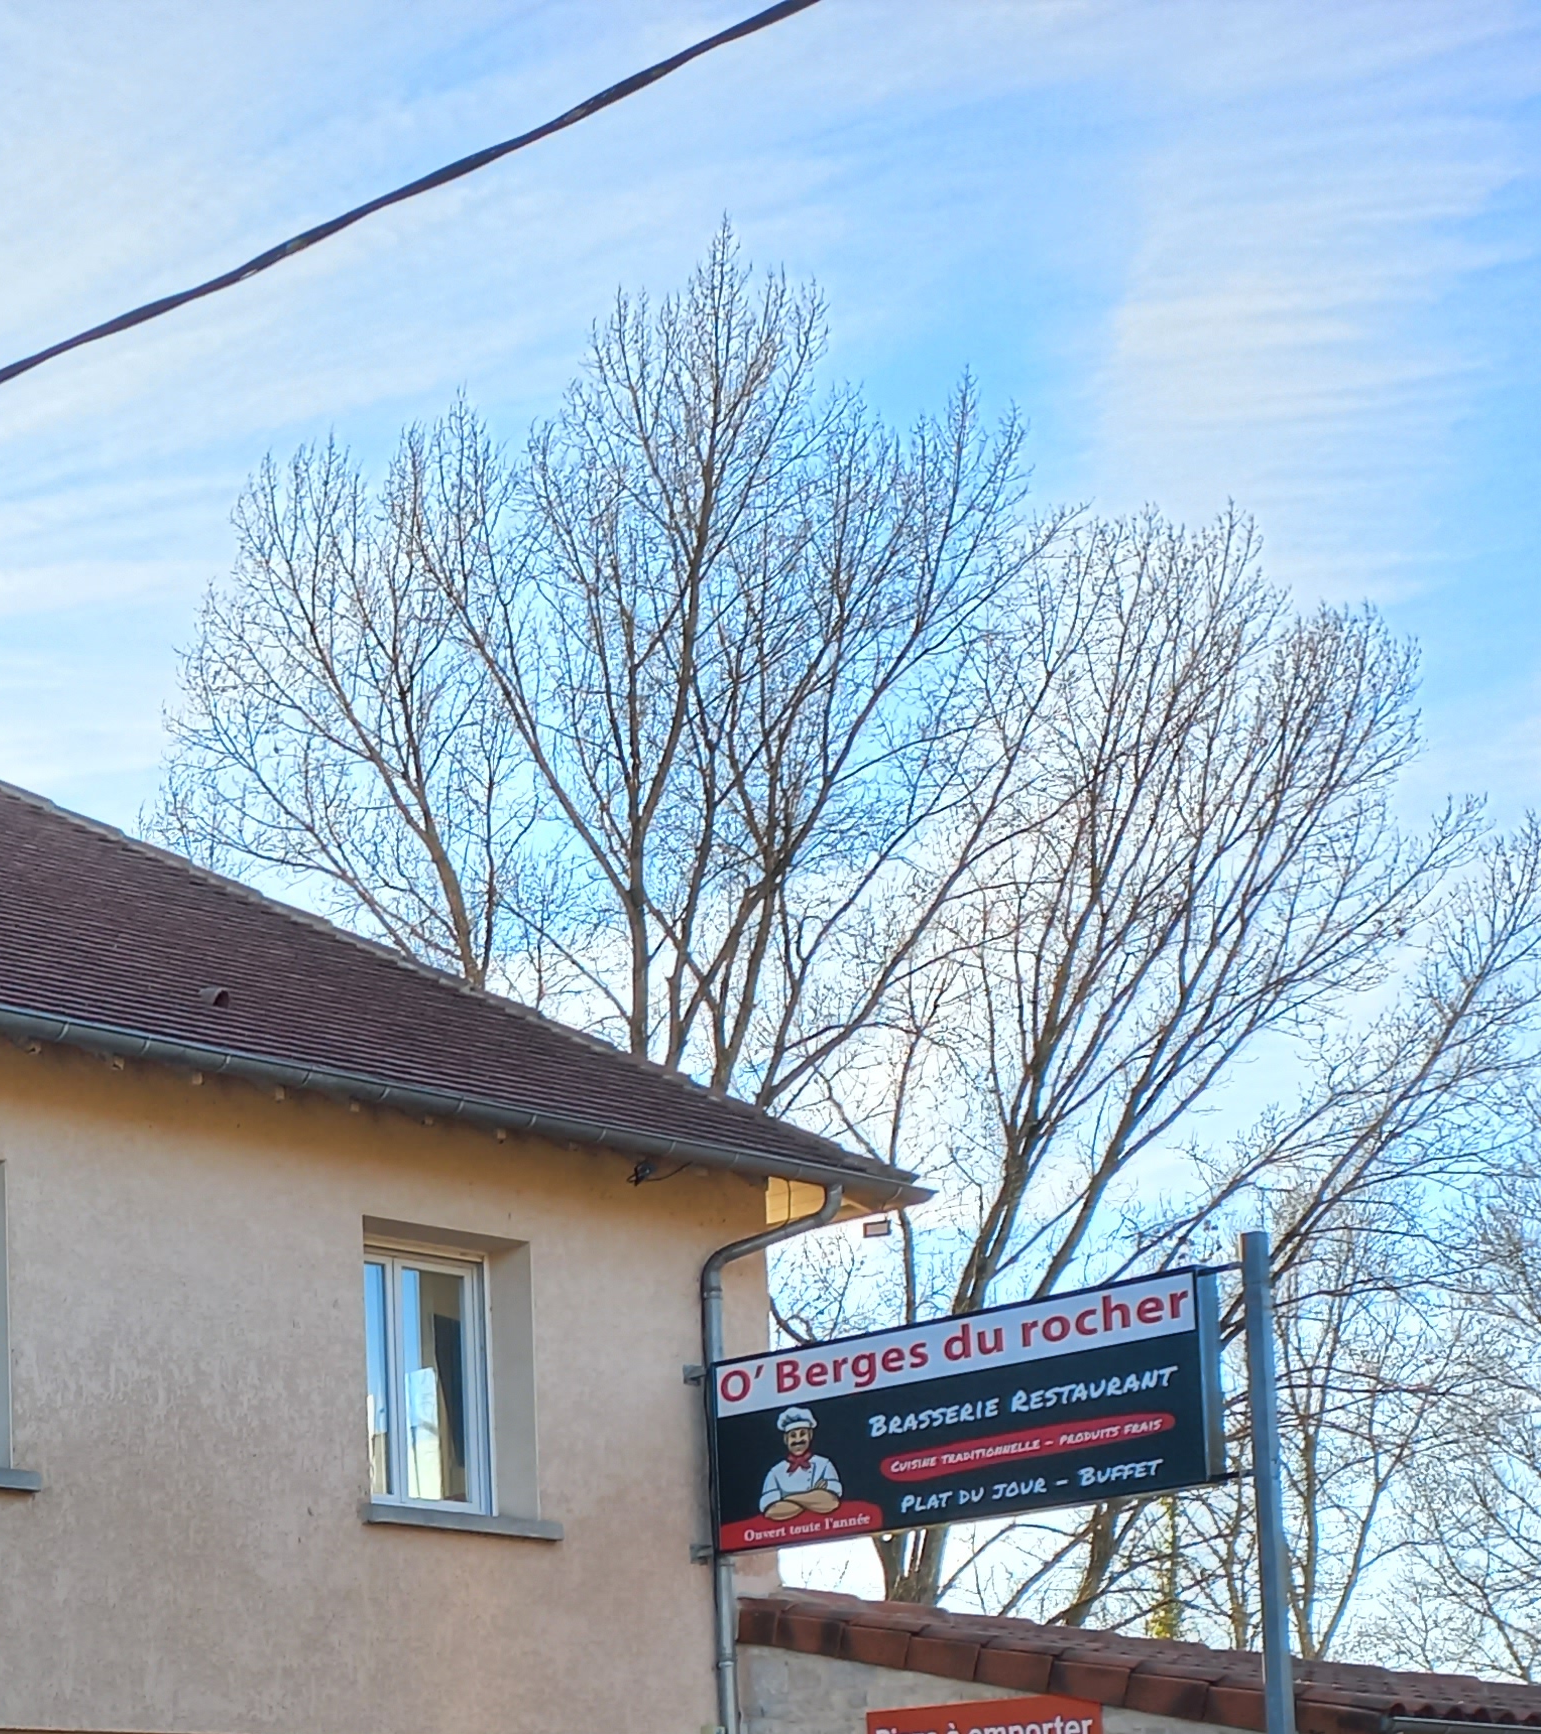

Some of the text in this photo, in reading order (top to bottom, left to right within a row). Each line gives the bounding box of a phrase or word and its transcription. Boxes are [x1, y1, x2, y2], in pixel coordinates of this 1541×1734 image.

[720, 1290, 1188, 1402] O' Berges du rocher
[869, 1366, 1178, 1437] BRASSERIE RESTAURANT
[901, 1491, 952, 1513] PLAT
[959, 1487, 984, 1505] DU
[992, 1477, 1047, 1500] JOUR
[1077, 1459, 1163, 1487] BUFFET
[744, 1514, 870, 1543] Ouvert toute l'année
